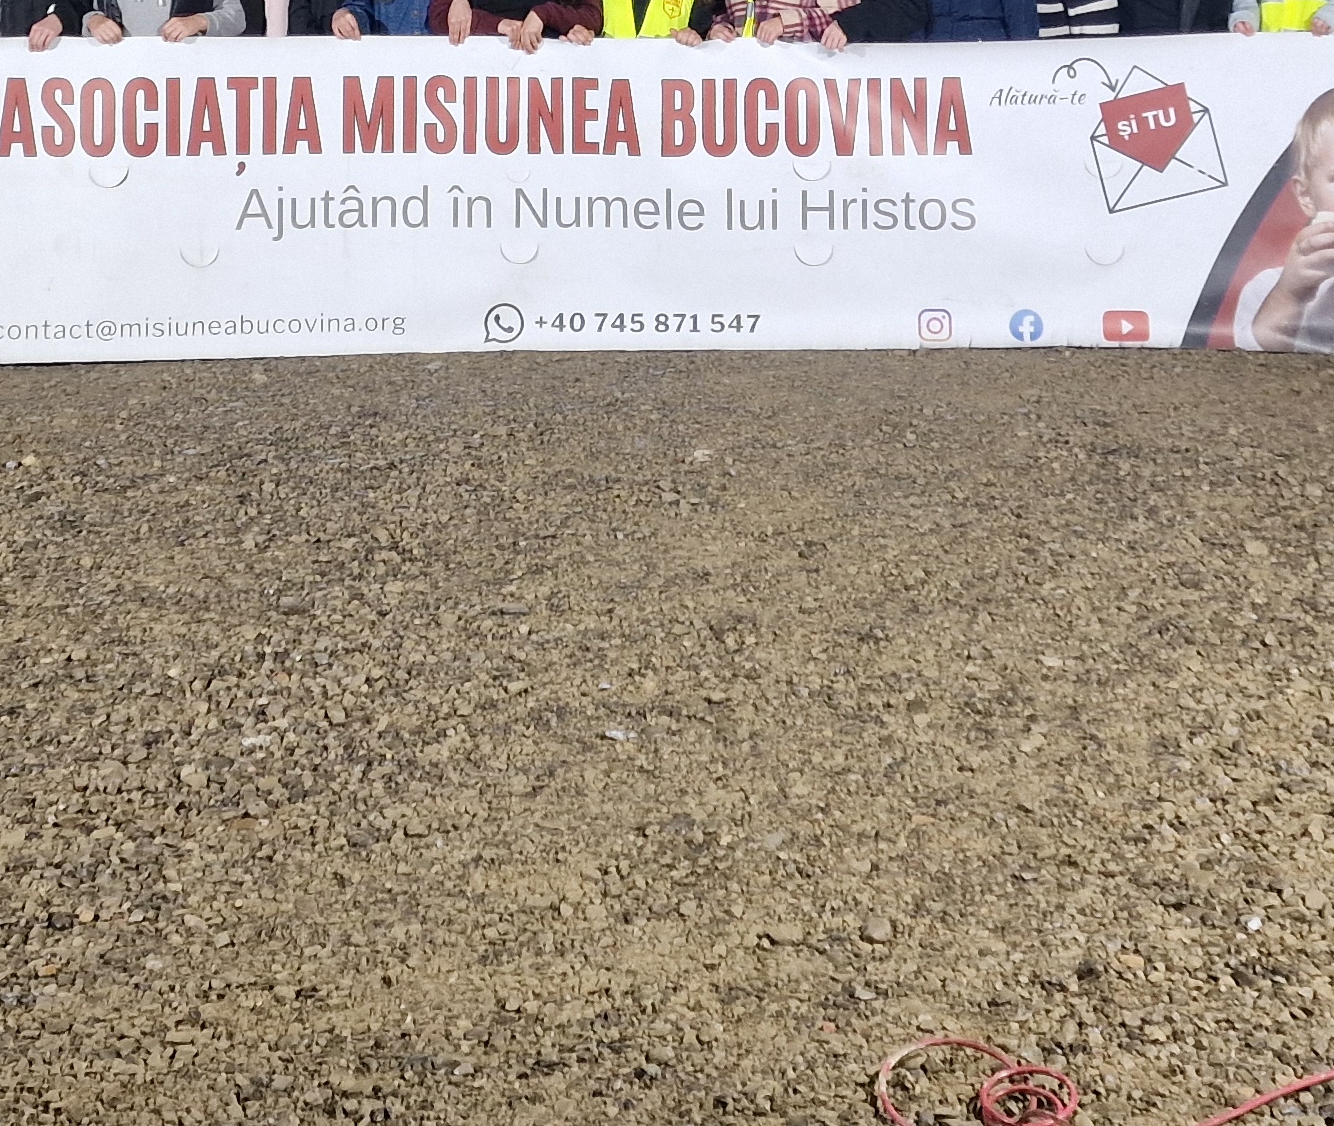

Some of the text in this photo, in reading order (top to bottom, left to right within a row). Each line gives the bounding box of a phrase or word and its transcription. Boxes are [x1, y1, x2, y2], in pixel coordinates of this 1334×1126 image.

[989, 86, 1088, 107] Alătură-te
[343, 75, 642, 156] MISIUNEA
[661, 77, 974, 157] BUCOVINA
[1117, 106, 1177, 140] și TU
[236, 185, 977, 242] Ajutând în Numele lui Hristos
[535, 313, 762, 335] +40 745 871 547
